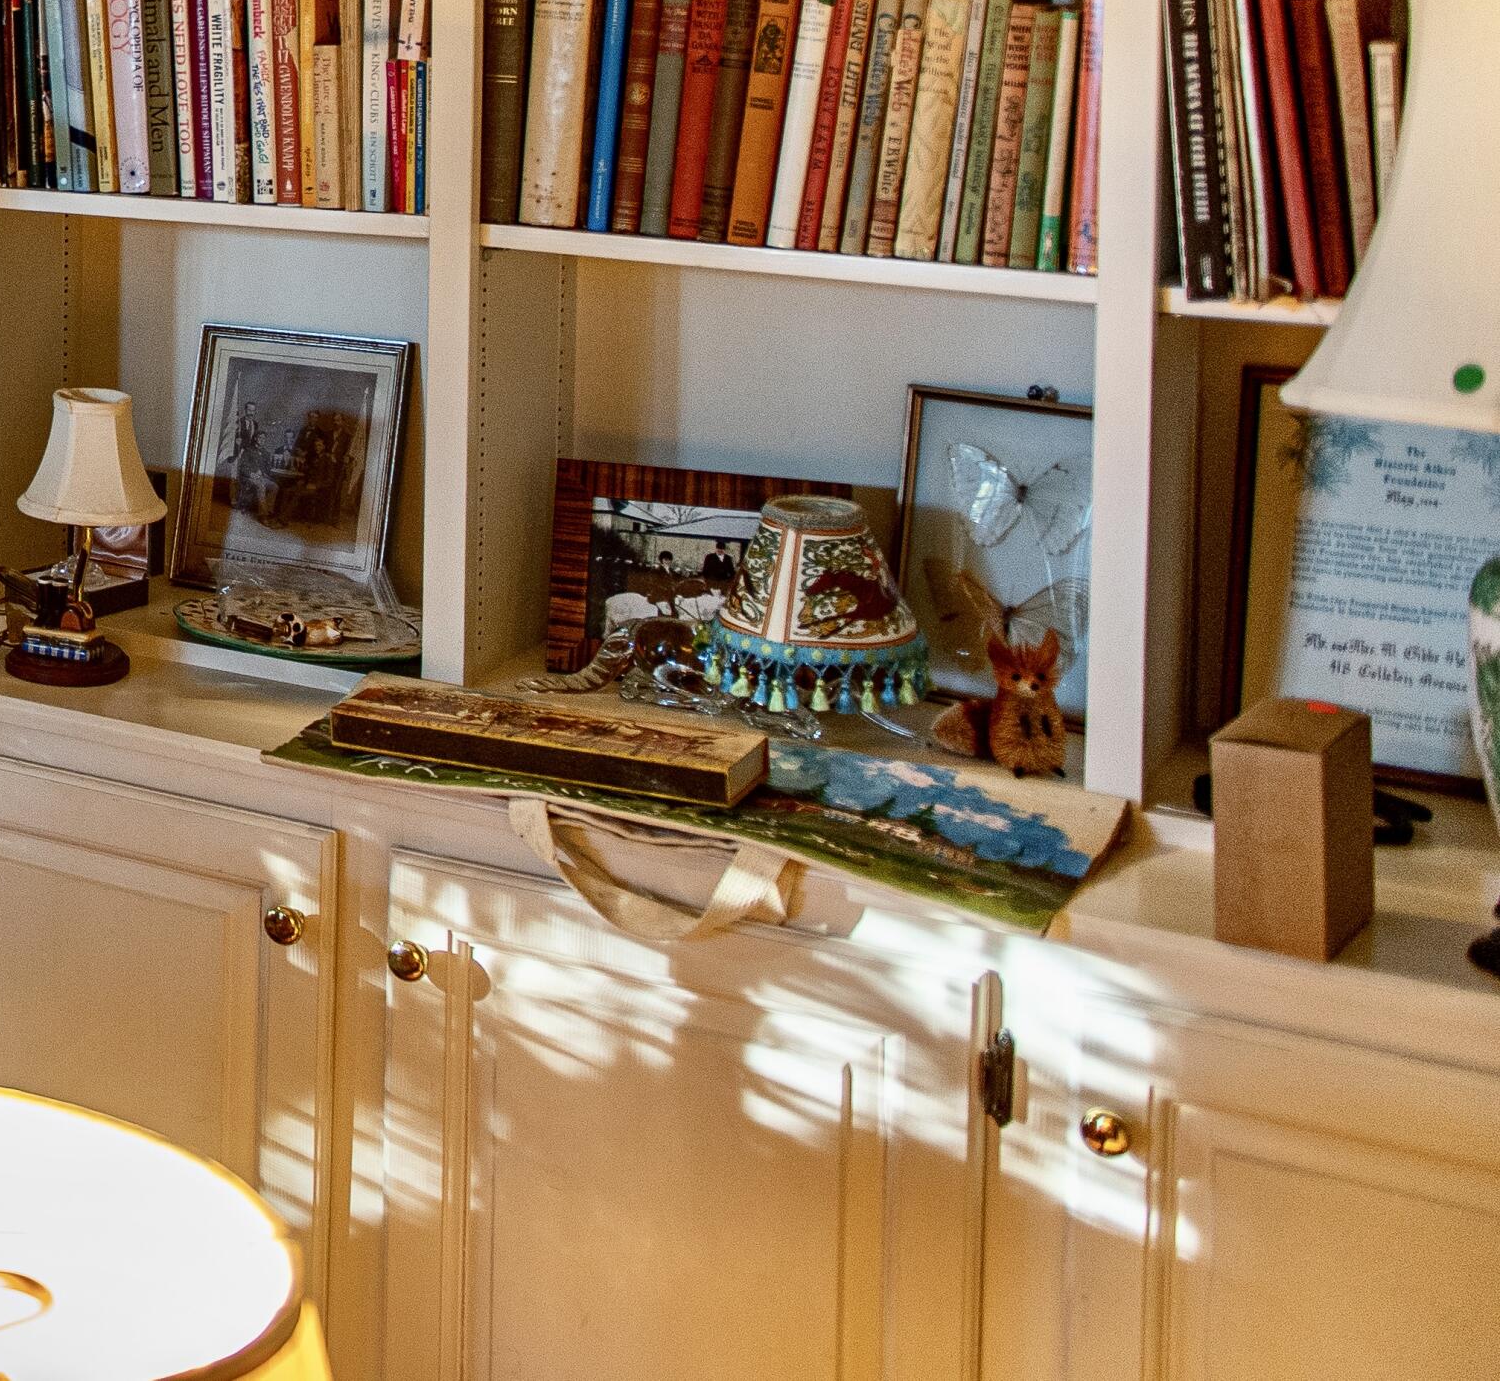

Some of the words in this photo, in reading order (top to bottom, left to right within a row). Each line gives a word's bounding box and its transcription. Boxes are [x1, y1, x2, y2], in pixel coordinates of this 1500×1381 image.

[173, 21, 186, 65] NEED
[196, 7, 206, 50] GARDENS
[211, 14, 223, 49] WHITE
[850, 0, 869, 54] STUART
[1010, 25, 1032, 33] WHEN
[322, 57, 331, 75] The
[370, 53, 381, 81] KING
[868, 12, 896, 91] Charlotte's
[133, 75, 144, 92] OF
[147, 58, 166, 98] and
[199, 62, 208, 91] ELLEN
[212, 53, 225, 105] FRAGILITY
[322, 78, 332, 100] Lure
[841, 61, 859, 110] LITTLE
[984, 62, 997, 82] THE
[250, 64, 260, 80] THE
[255, 97, 266, 117] THAT
[278, 65, 292, 134] GWENDOLYN
[313, 75, 322, 116] Limerick
[370, 90, 381, 124] CLUBS
[821, 66, 838, 117] PONY
[892, 78, 913, 112] Web
[200, 92, 209, 128] BIDDLE
[323, 105, 332, 115] of
[864, 94, 882, 127] Web
[149, 105, 170, 154] Men
[178, 119, 191, 155] TOO
[253, 121, 261, 137] AND
[369, 131, 378, 147] BEN
[957, 122, 968, 146] under
[202, 130, 212, 173] SHIPMAN
[256, 139, 269, 165] GAG!
[283, 137, 293, 171] KNAPP
[812, 124, 829, 171] FARM
[951, 148, 964, 179] Ground
[369, 149, 378, 182] SCHOTT
[880, 158, 898, 194] White
[800, 201, 814, 244] BROWN
[1374, 458, 1418, 471] Historic
[1407, 445, 1425, 458] The
[1384, 474, 1445, 490] Foundation
